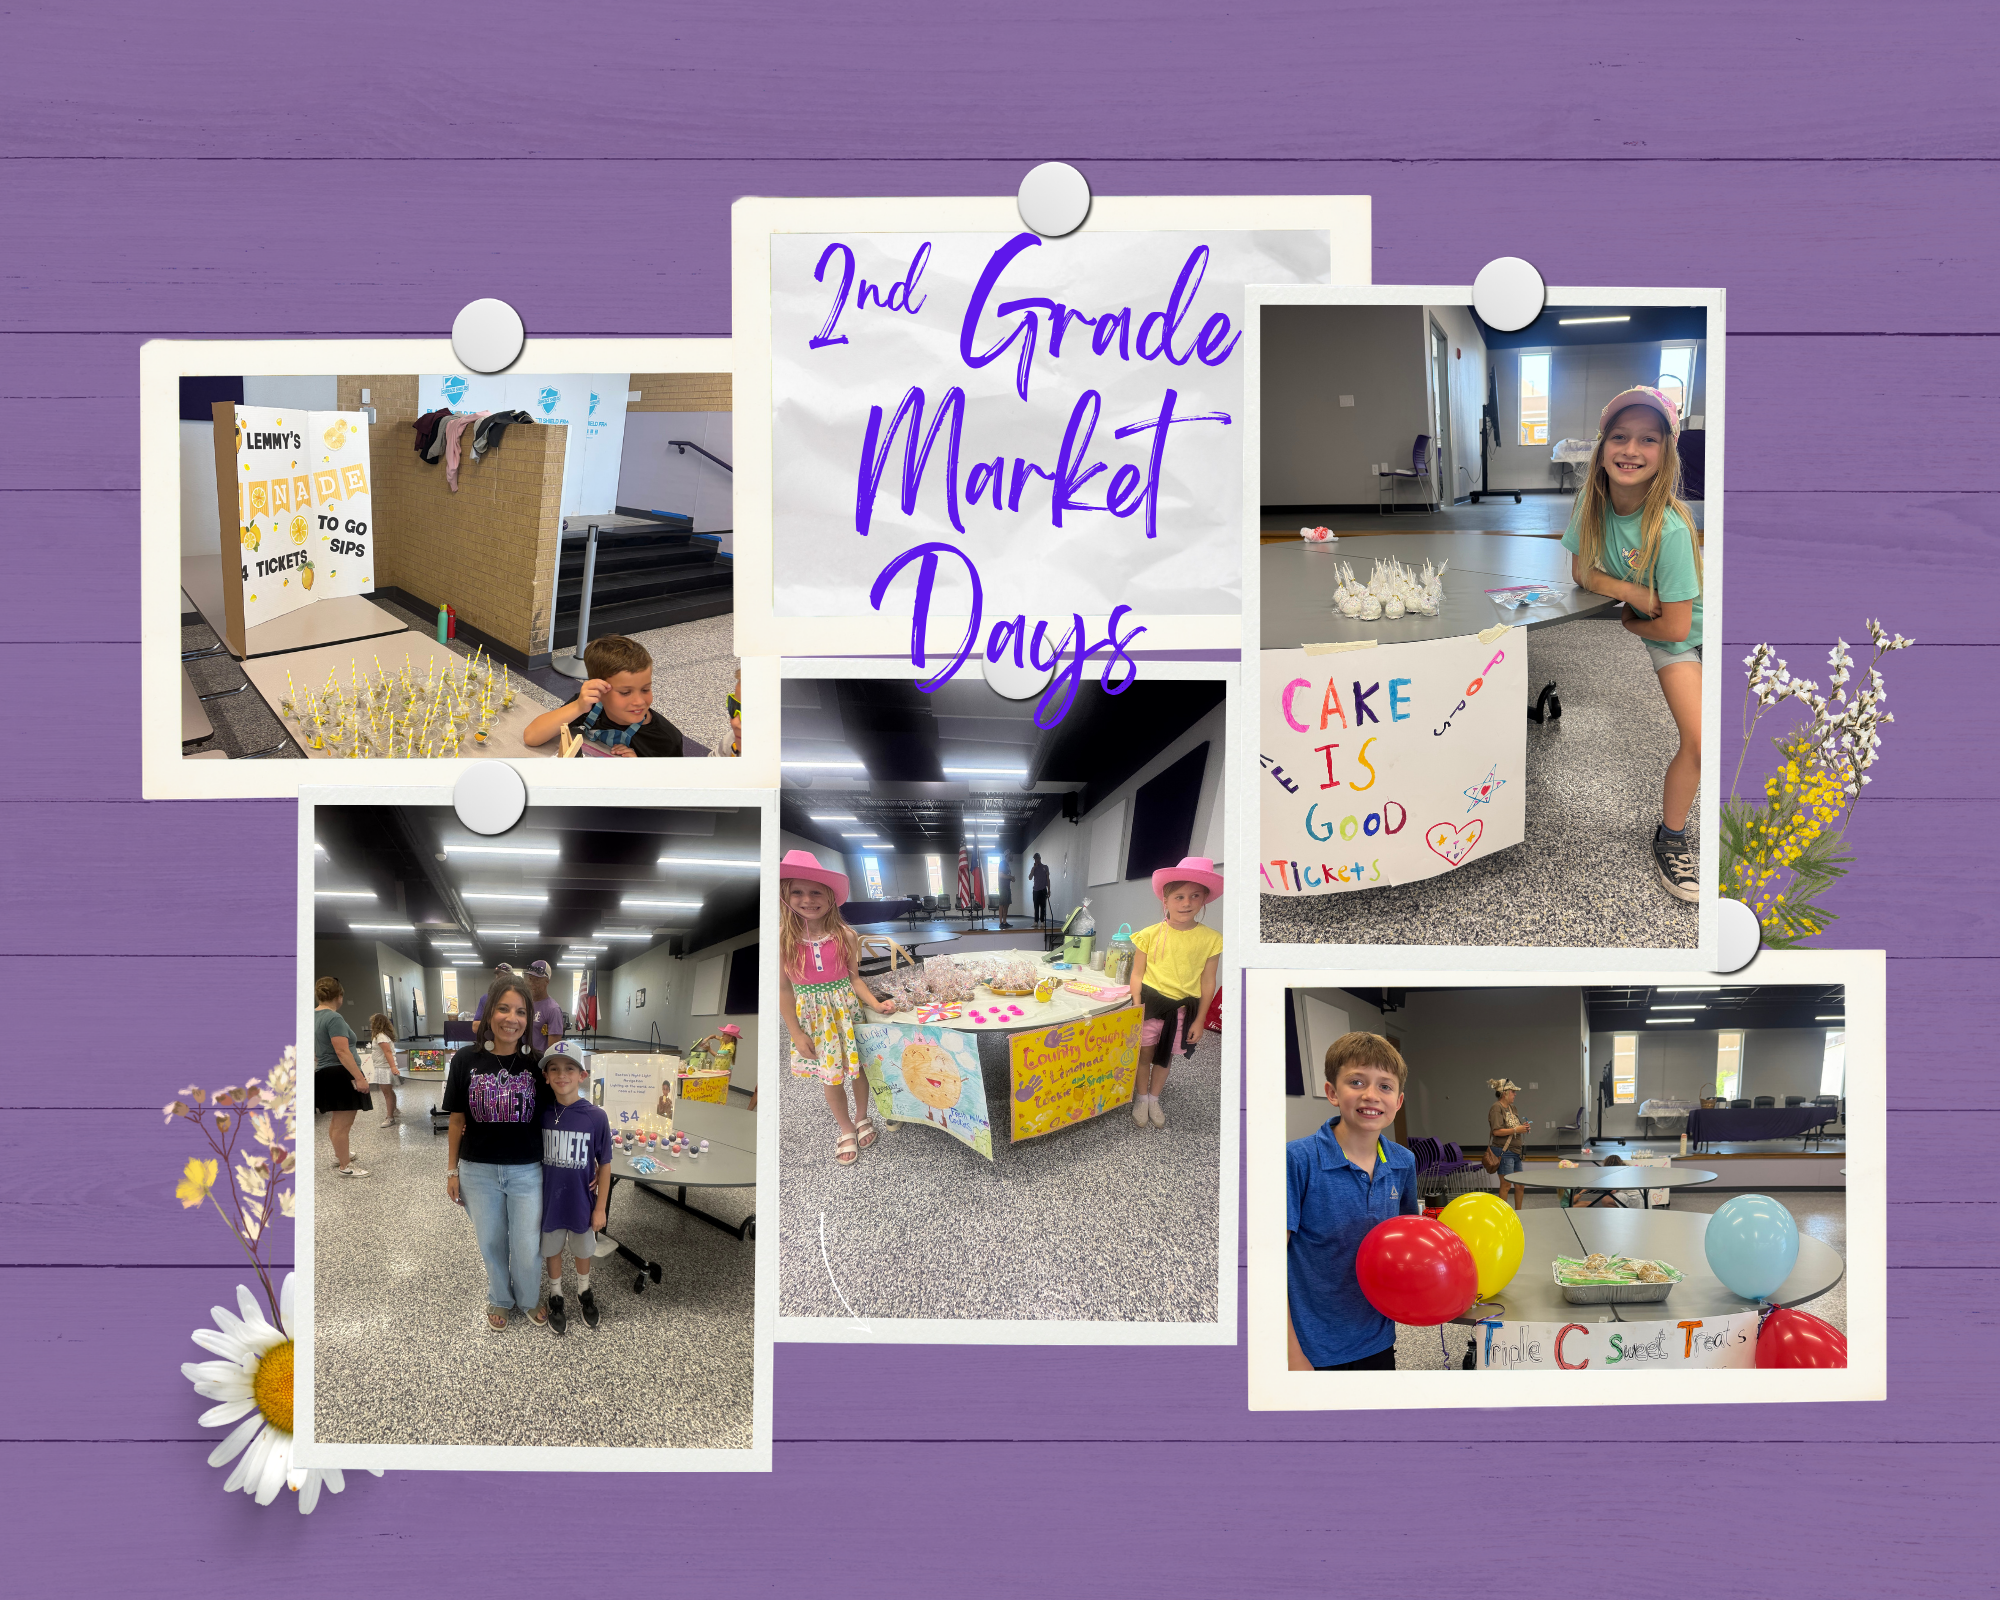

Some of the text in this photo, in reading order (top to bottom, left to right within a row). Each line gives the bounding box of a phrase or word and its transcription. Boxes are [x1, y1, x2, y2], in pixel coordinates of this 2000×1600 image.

[246, 430, 301, 450] LEMMY'S
[239, 469, 364, 510] ONADE
[317, 514, 367, 536] TO GO
[255, 549, 308, 578] TICKETS
[329, 538, 366, 558] SIPS
[1281, 676, 1412, 733] CAKE
[1433, 649, 1505, 736] POPS
[1314, 737, 1377, 791] IS
[1023, 1044, 1081, 1070] Country
[469, 1084, 536, 1123] HORNETS
[620, 1110, 640, 1124] $4
[1477, 1320, 1747, 1370] Triple C Sweet Treats
